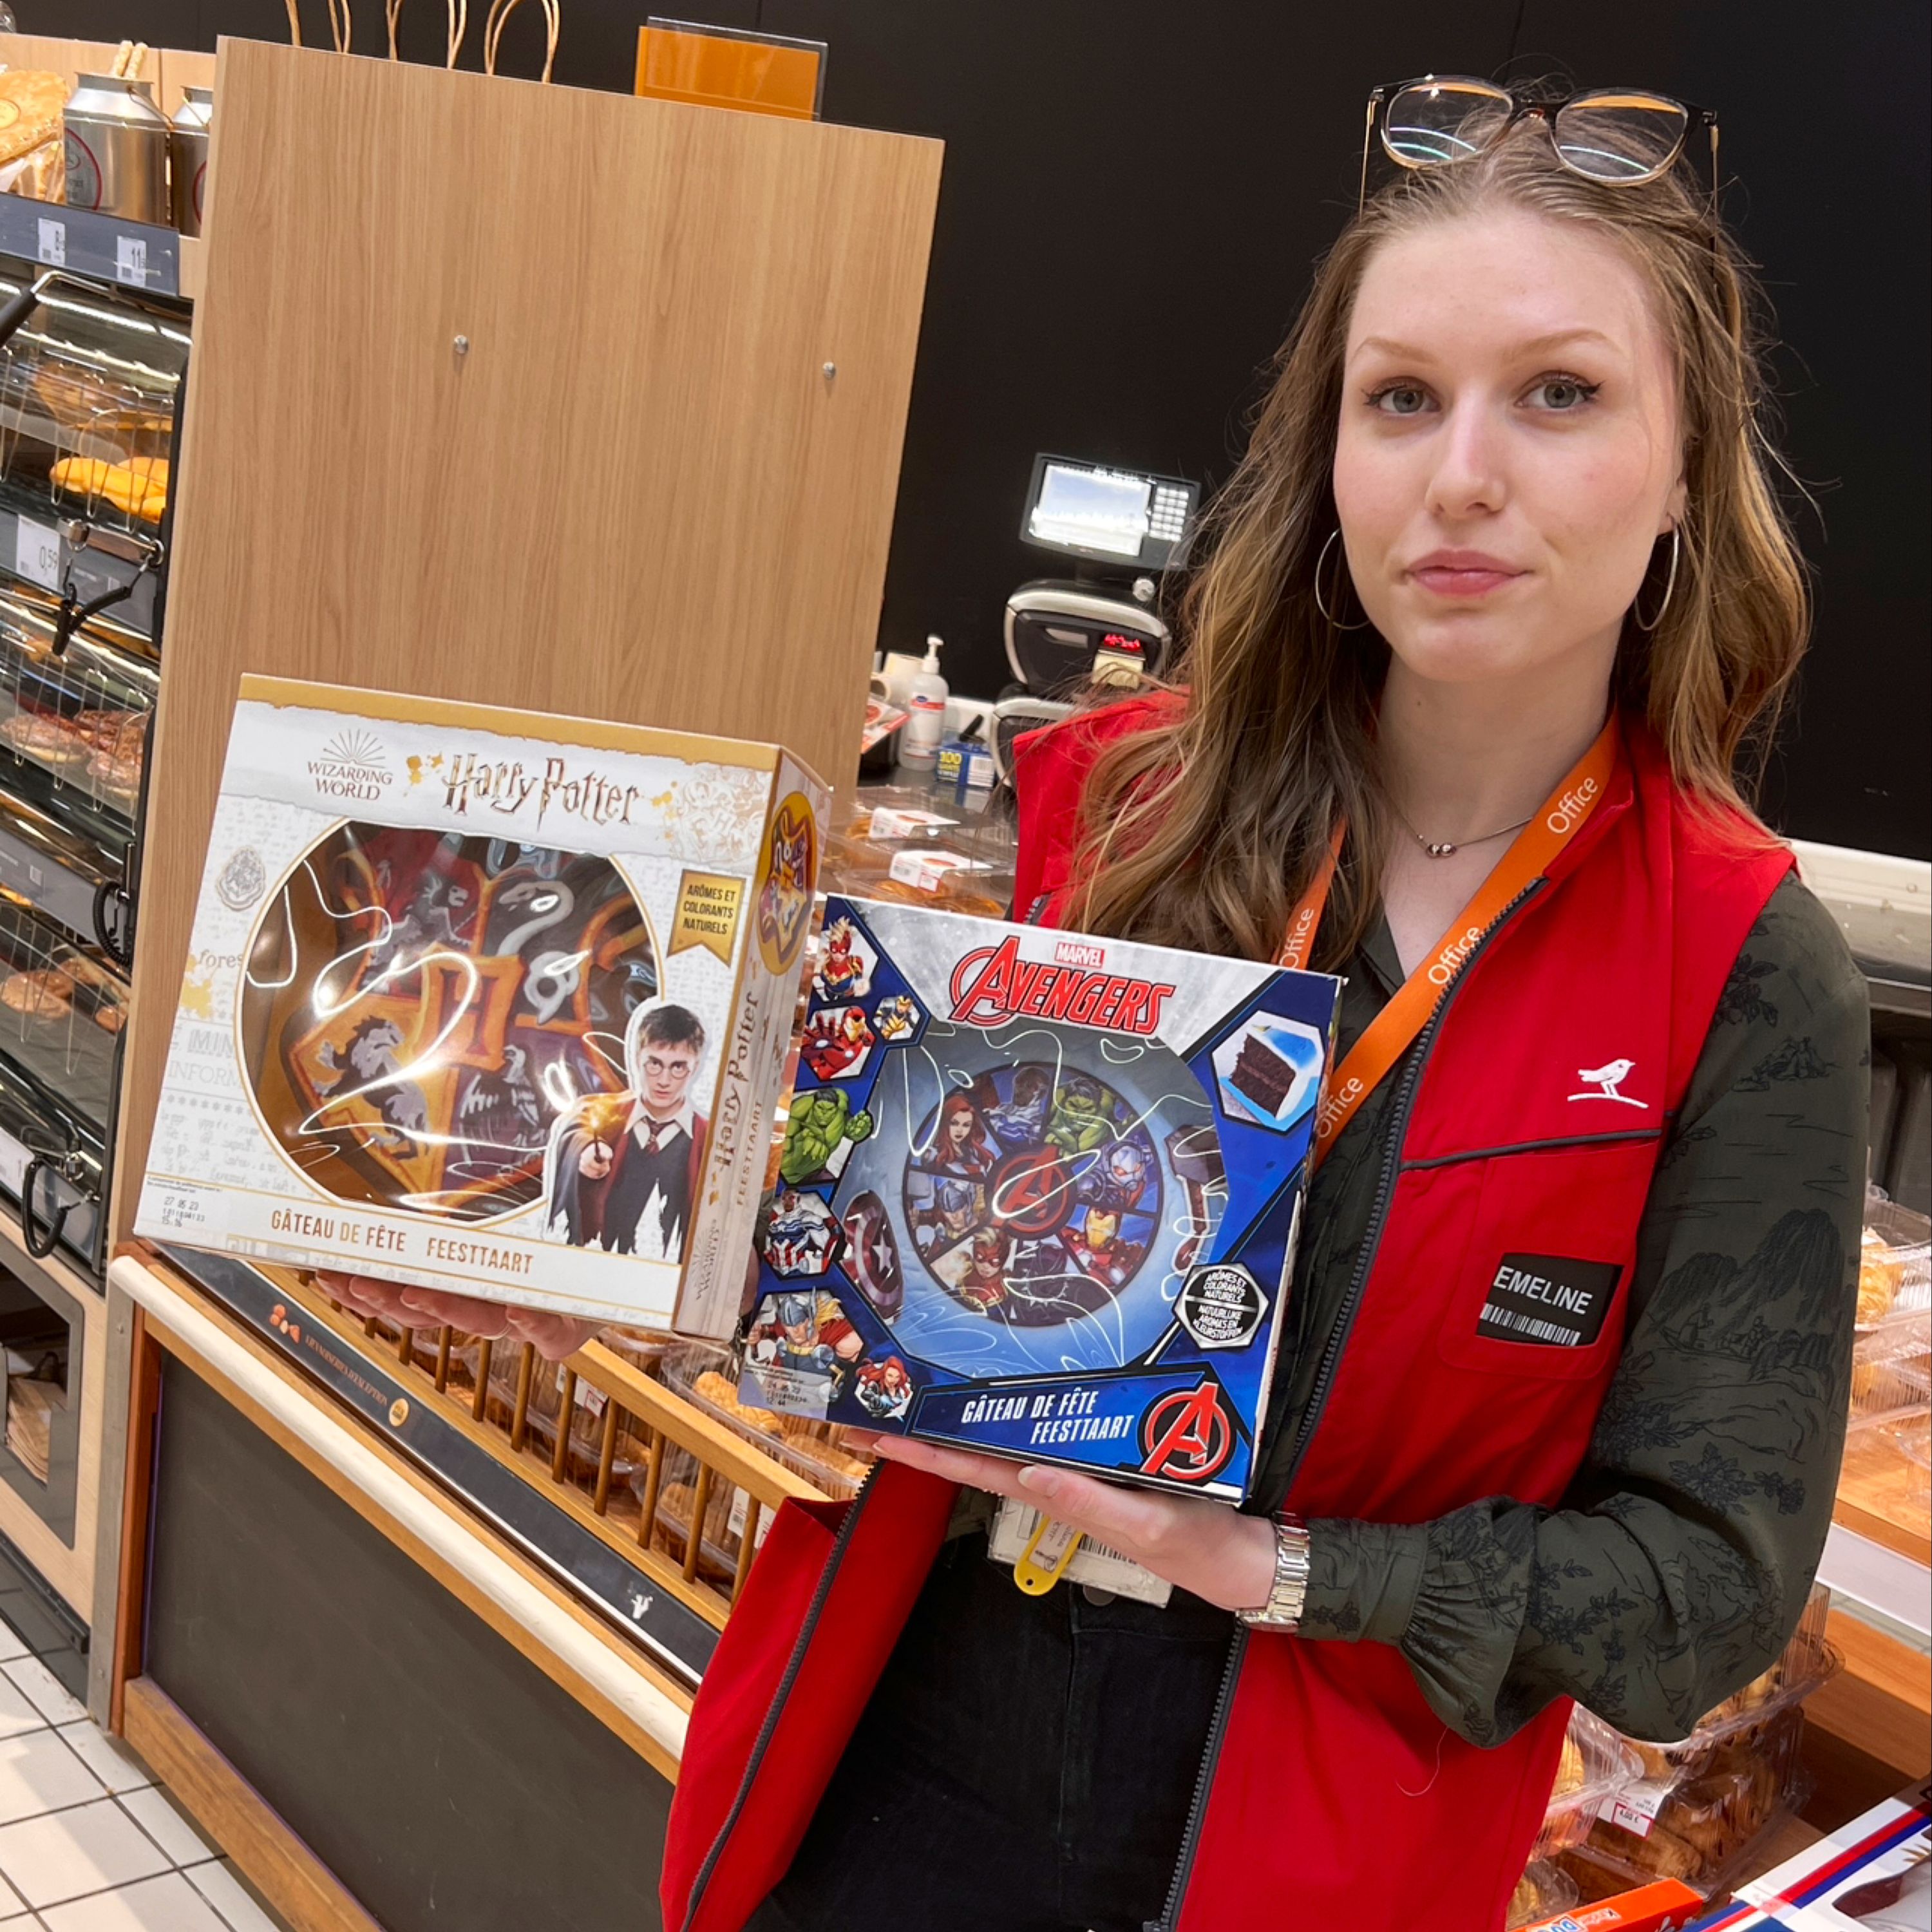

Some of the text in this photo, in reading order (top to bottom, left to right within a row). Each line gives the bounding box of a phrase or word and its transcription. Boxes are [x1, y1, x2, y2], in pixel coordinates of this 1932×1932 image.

[307, 761, 393, 786] WIZARDING
[314, 777, 381, 801] WORLD
[442, 752, 639, 833] Harry Potter
[1547, 777, 1598, 835] Office
[683, 900, 734, 919] COLORANTS
[687, 883, 736, 902] ARÔMES ET
[683, 917, 728, 935] NATURELS
[1280, 907, 1314, 969] Office
[1056, 943, 1104, 968] MARVEL
[1427, 925, 1481, 986] Office
[714, 990, 759, 1171] Harry Potter
[1316, 1075, 1364, 1139] Office
[271, 1208, 535, 1274] GÂTEAU DE FÊTE FEESTTAART
[1204, 1289, 1242, 1303] NATURELS
[1493, 1265, 1594, 1315] EMELINE
[960, 1386, 1099, 1424] GÂTEAU DE FÊTE
[1029, 1414, 1135, 1445] FEESTTAART
